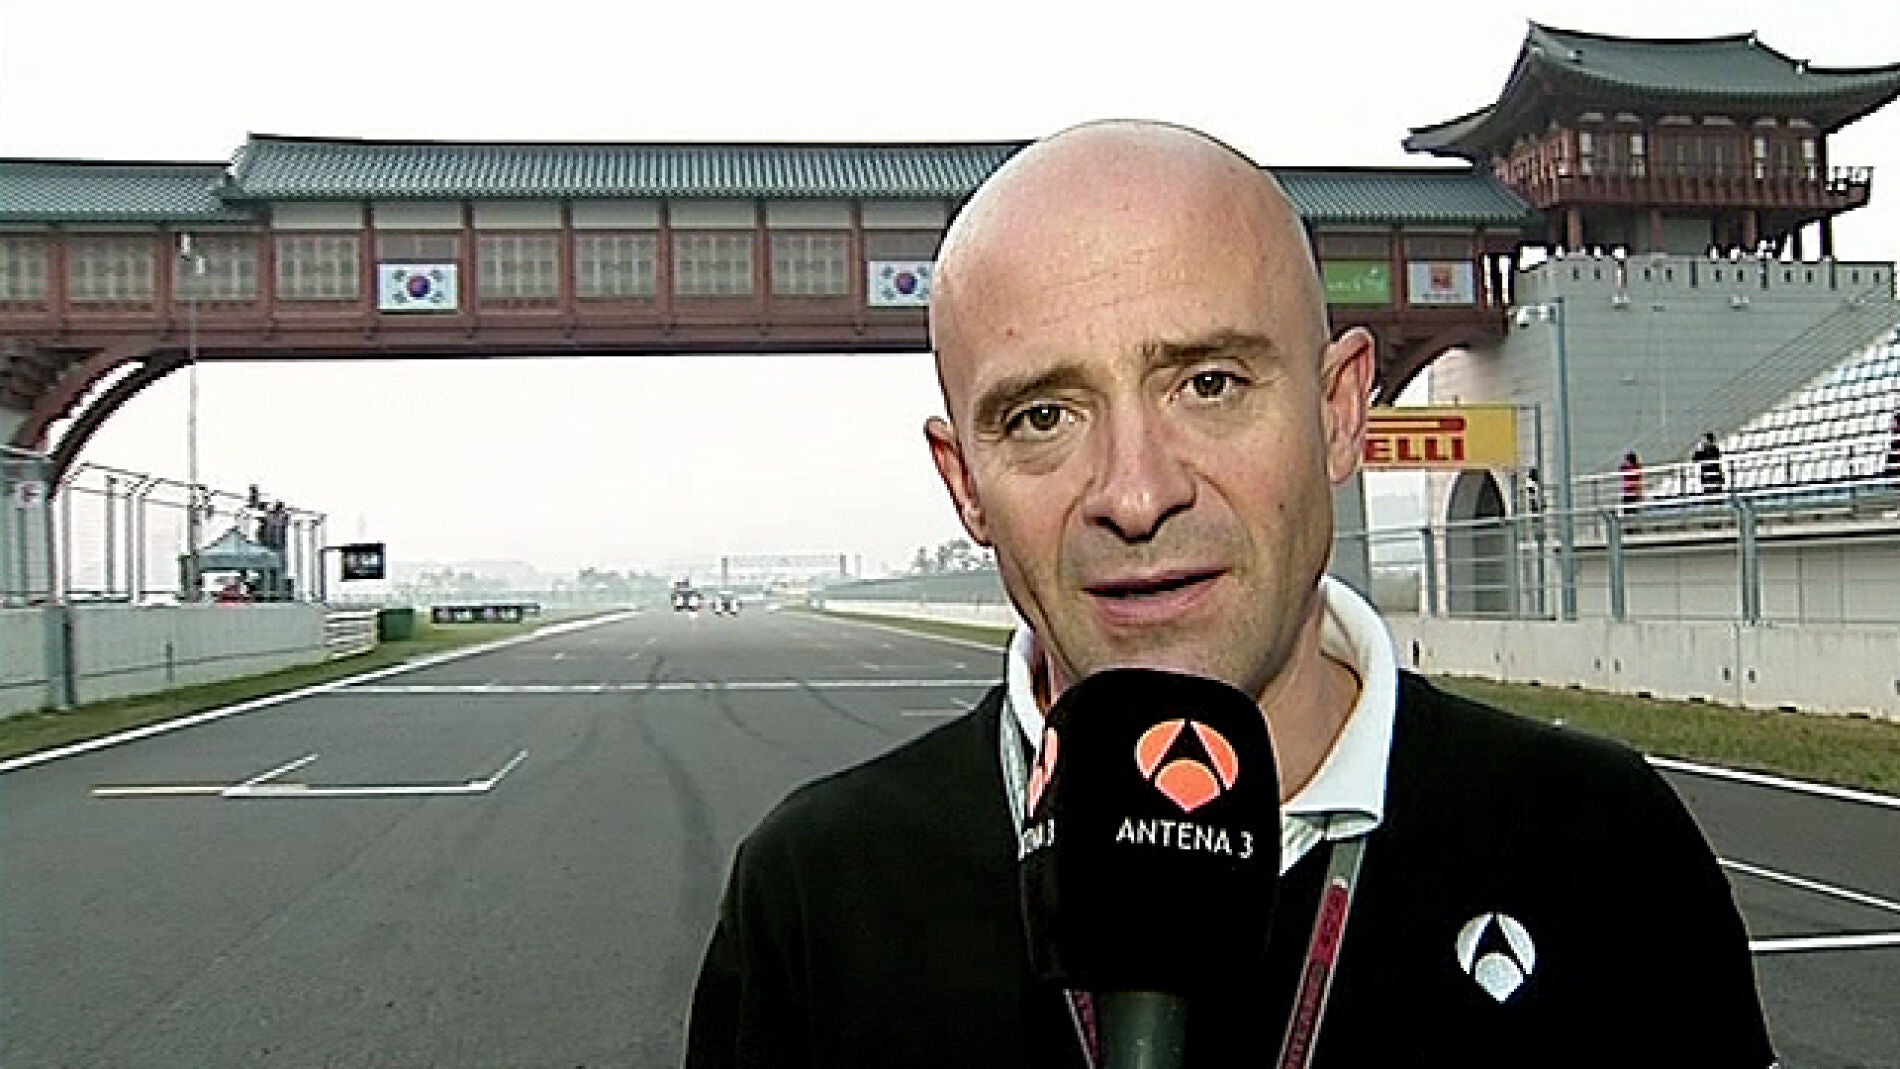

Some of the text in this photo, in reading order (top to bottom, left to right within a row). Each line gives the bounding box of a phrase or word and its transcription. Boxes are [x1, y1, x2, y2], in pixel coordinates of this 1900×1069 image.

[1364, 438, 1465, 462] ELLI
[1115, 816, 1254, 859] ANTENA 3
